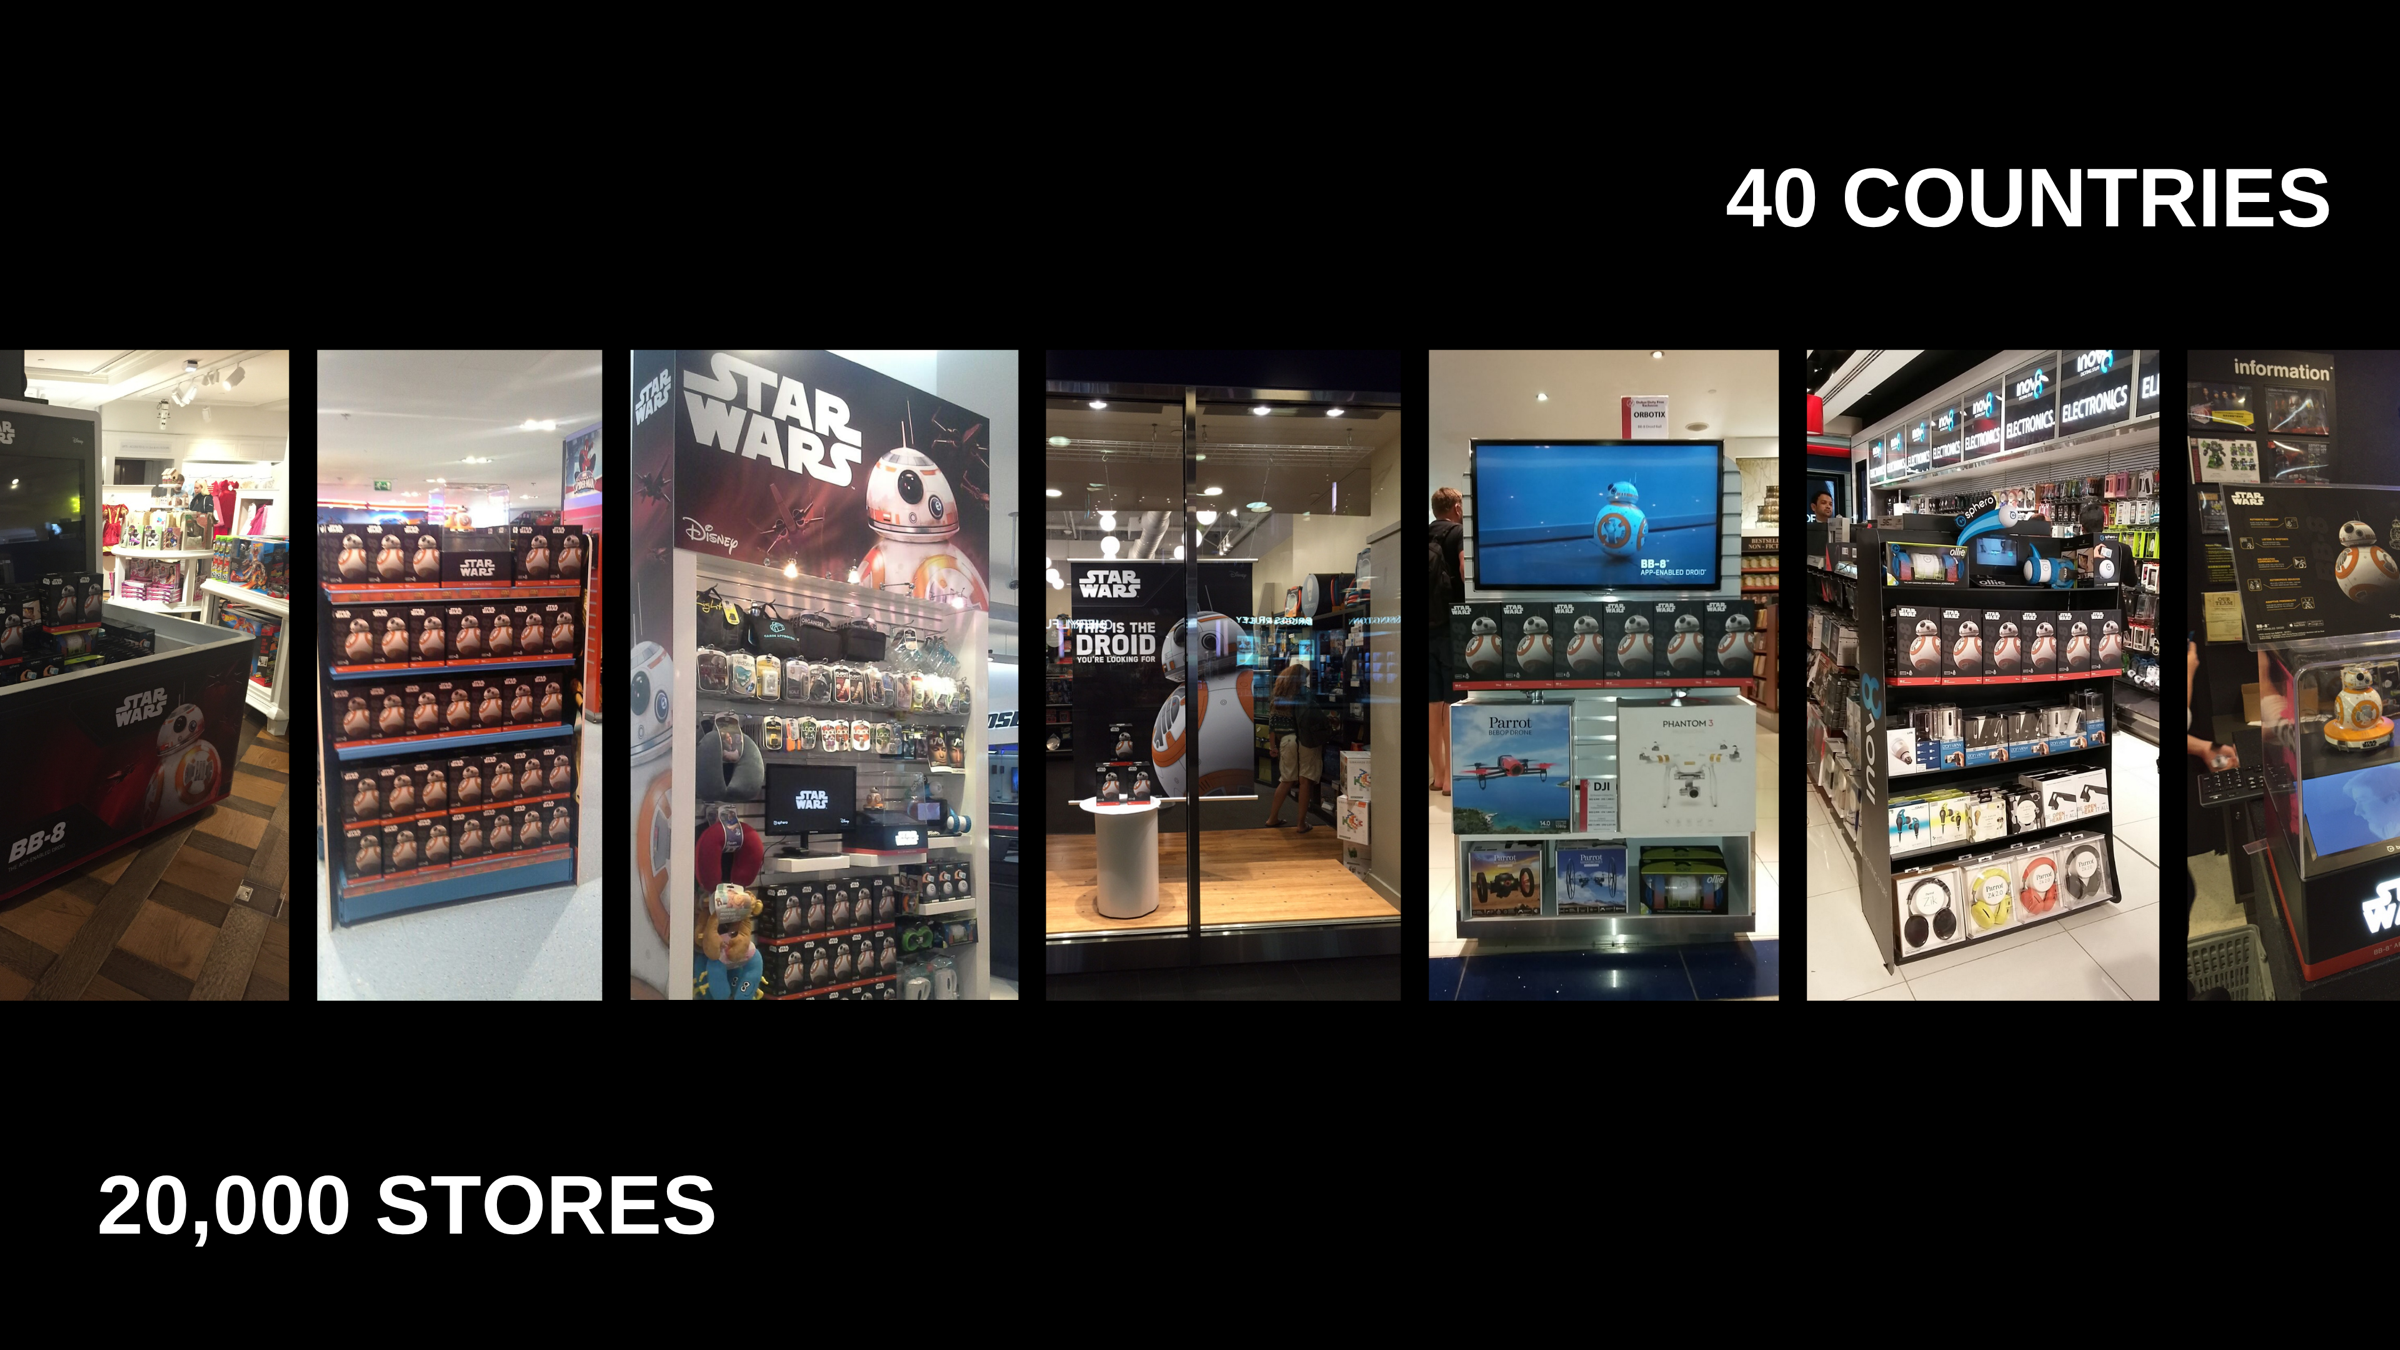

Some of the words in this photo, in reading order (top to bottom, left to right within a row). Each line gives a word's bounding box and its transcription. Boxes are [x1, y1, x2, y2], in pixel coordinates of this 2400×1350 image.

[2234, 358, 2330, 382] information
[636, 368, 671, 410] STAR
[635, 384, 671, 426] WARS
[683, 352, 862, 448] STAR
[2062, 385, 2128, 423] ELECTRONICS
[2006, 410, 2054, 439] ELECTRONICS
[683, 390, 862, 488] WARS
[1965, 427, 2000, 450] ELECTRONICS
[1964, 496, 1994, 518] sphero
[1950, 547, 1965, 556] ollie
[460, 559, 495, 567] STAR
[460, 568, 495, 576] WARS
[1079, 570, 1140, 584] STAR
[1079, 584, 1140, 598] WARS
[1112, 622, 1125, 633] IS
[1130, 622, 1156, 633] THE
[1076, 634, 1156, 655] DROID
[116, 687, 167, 714] STAR
[116, 700, 167, 727] WARS
[1489, 716, 1532, 728] Parrot
[796, 790, 828, 800] STAR
[1594, 782, 1610, 791] DJI
[796, 800, 828, 809] WARS
[8, 822, 66, 864] BB-8
[1707, 875, 1724, 884] ollie
[2036, 872, 2052, 880] Parrot
[1986, 883, 2004, 892] Parrot
